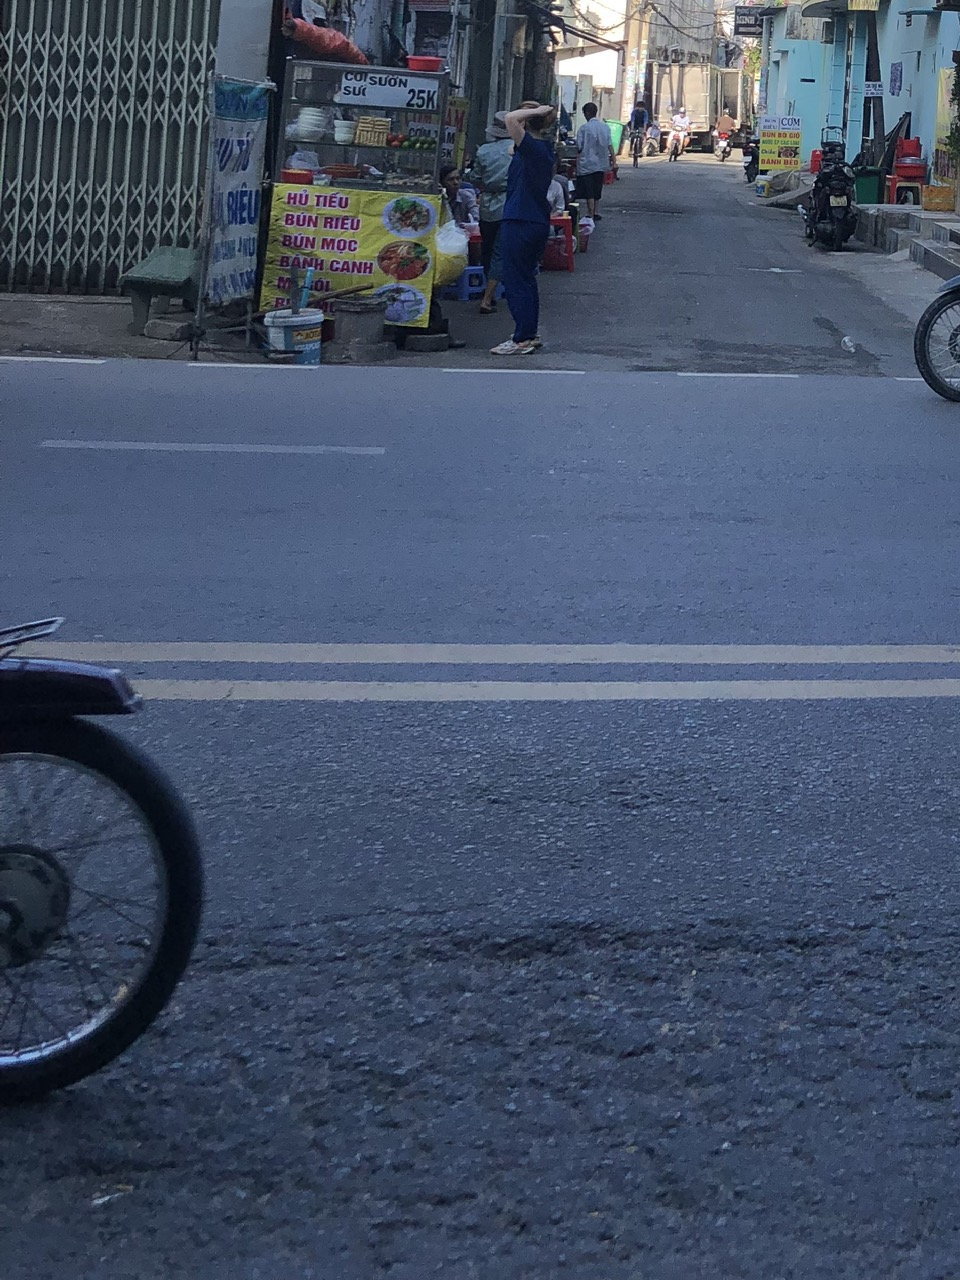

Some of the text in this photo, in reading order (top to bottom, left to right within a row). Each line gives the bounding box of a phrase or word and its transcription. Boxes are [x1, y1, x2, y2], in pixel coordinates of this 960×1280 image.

[406, 88, 437, 109] 25K
[286, 189, 349, 209] HỦ TIẾU
[284, 212, 361, 231] BÚN RIÊU
[282, 233, 359, 253] BÚN MỌC
[279, 254, 374, 275] BÁNH CANH
